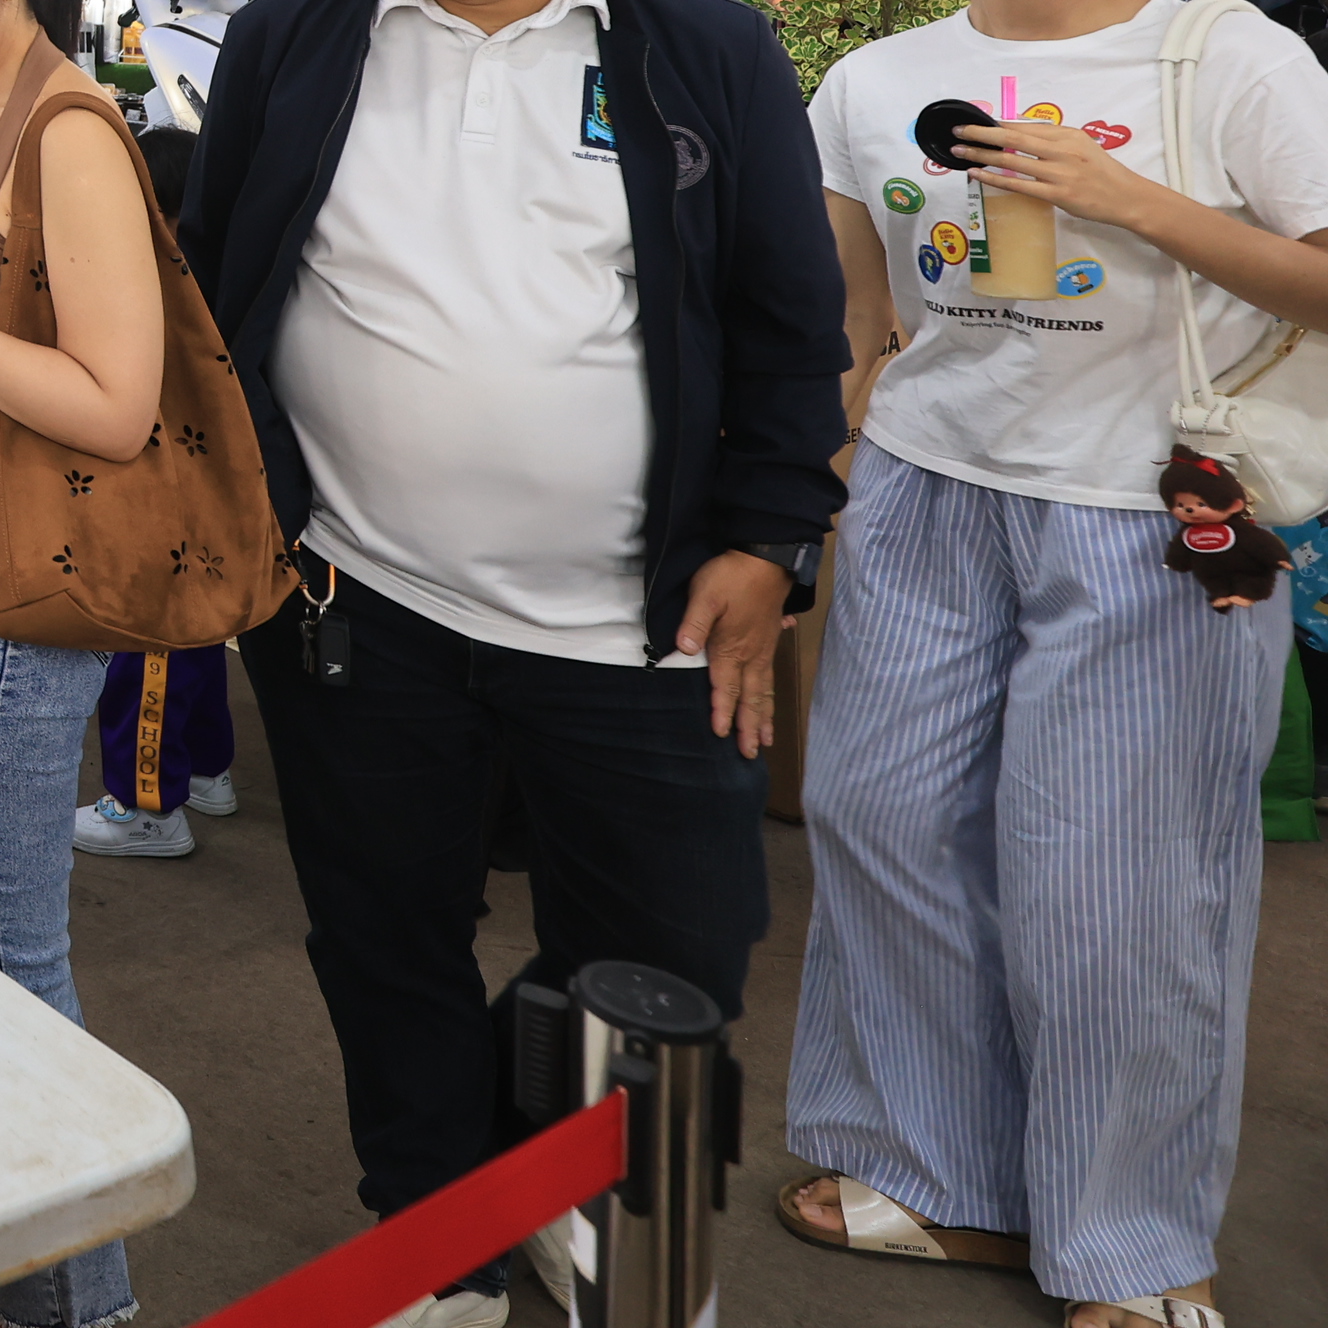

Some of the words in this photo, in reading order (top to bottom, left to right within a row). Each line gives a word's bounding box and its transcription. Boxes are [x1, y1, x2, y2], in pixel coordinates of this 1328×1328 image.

[946, 305, 997, 319] KITTY
[1001, 308, 1025, 323] AND
[1026, 315, 1104, 332] FRIENDS
[140, 690, 159, 794] SCHOOL
[884, 1242, 929, 1254] BIRKENSTOCK
